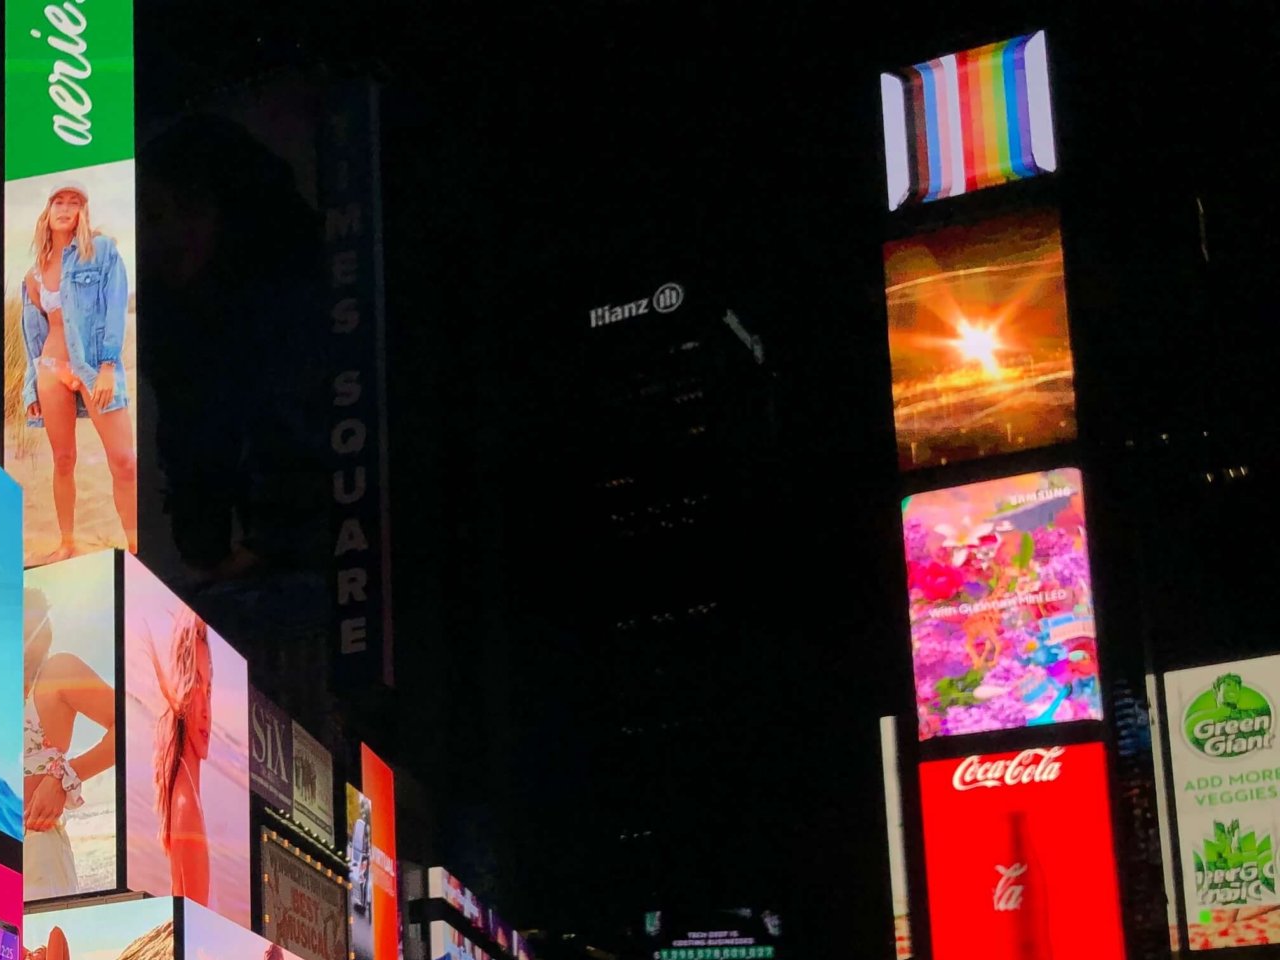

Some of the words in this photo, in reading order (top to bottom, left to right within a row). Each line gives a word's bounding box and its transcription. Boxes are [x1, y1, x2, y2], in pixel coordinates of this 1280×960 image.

[30, 0, 93, 147] aerie
[330, 370, 369, 655] SQUARE
[252, 702, 289, 783] SIX
[1193, 714, 1271, 740] Green
[1204, 732, 1273, 757] Giant
[952, 745, 1067, 791] Coca-Cola
[1184, 775, 1223, 793] ADD
[1228, 766, 1280, 786] MORE
[1194, 785, 1278, 807] VEGGIES
